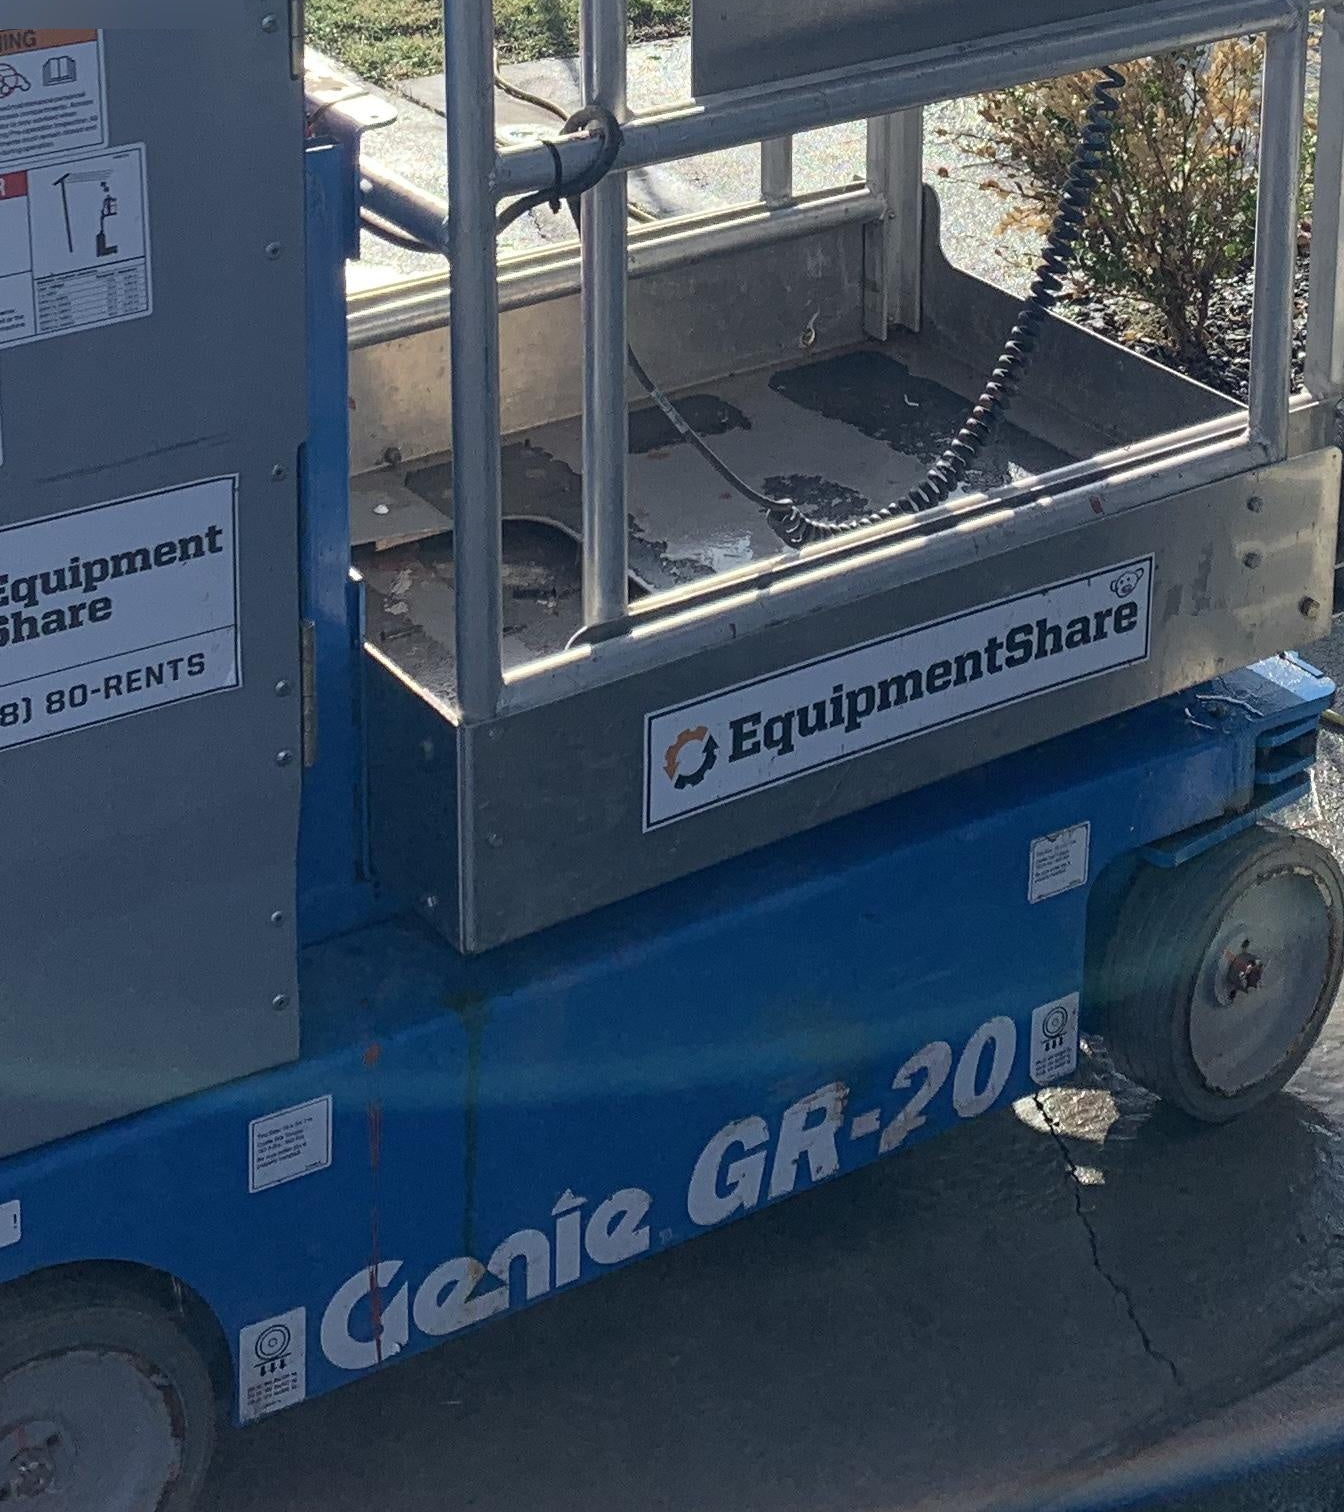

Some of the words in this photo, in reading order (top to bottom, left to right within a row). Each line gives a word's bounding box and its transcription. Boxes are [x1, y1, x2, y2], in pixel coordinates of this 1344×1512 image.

[45, 652, 206, 715] 80-RENTS
[727, 598, 1138, 765] EquipmentShare
[319, 1186, 651, 1370] Genie
[687, 1014, 1018, 1228] GR-20
